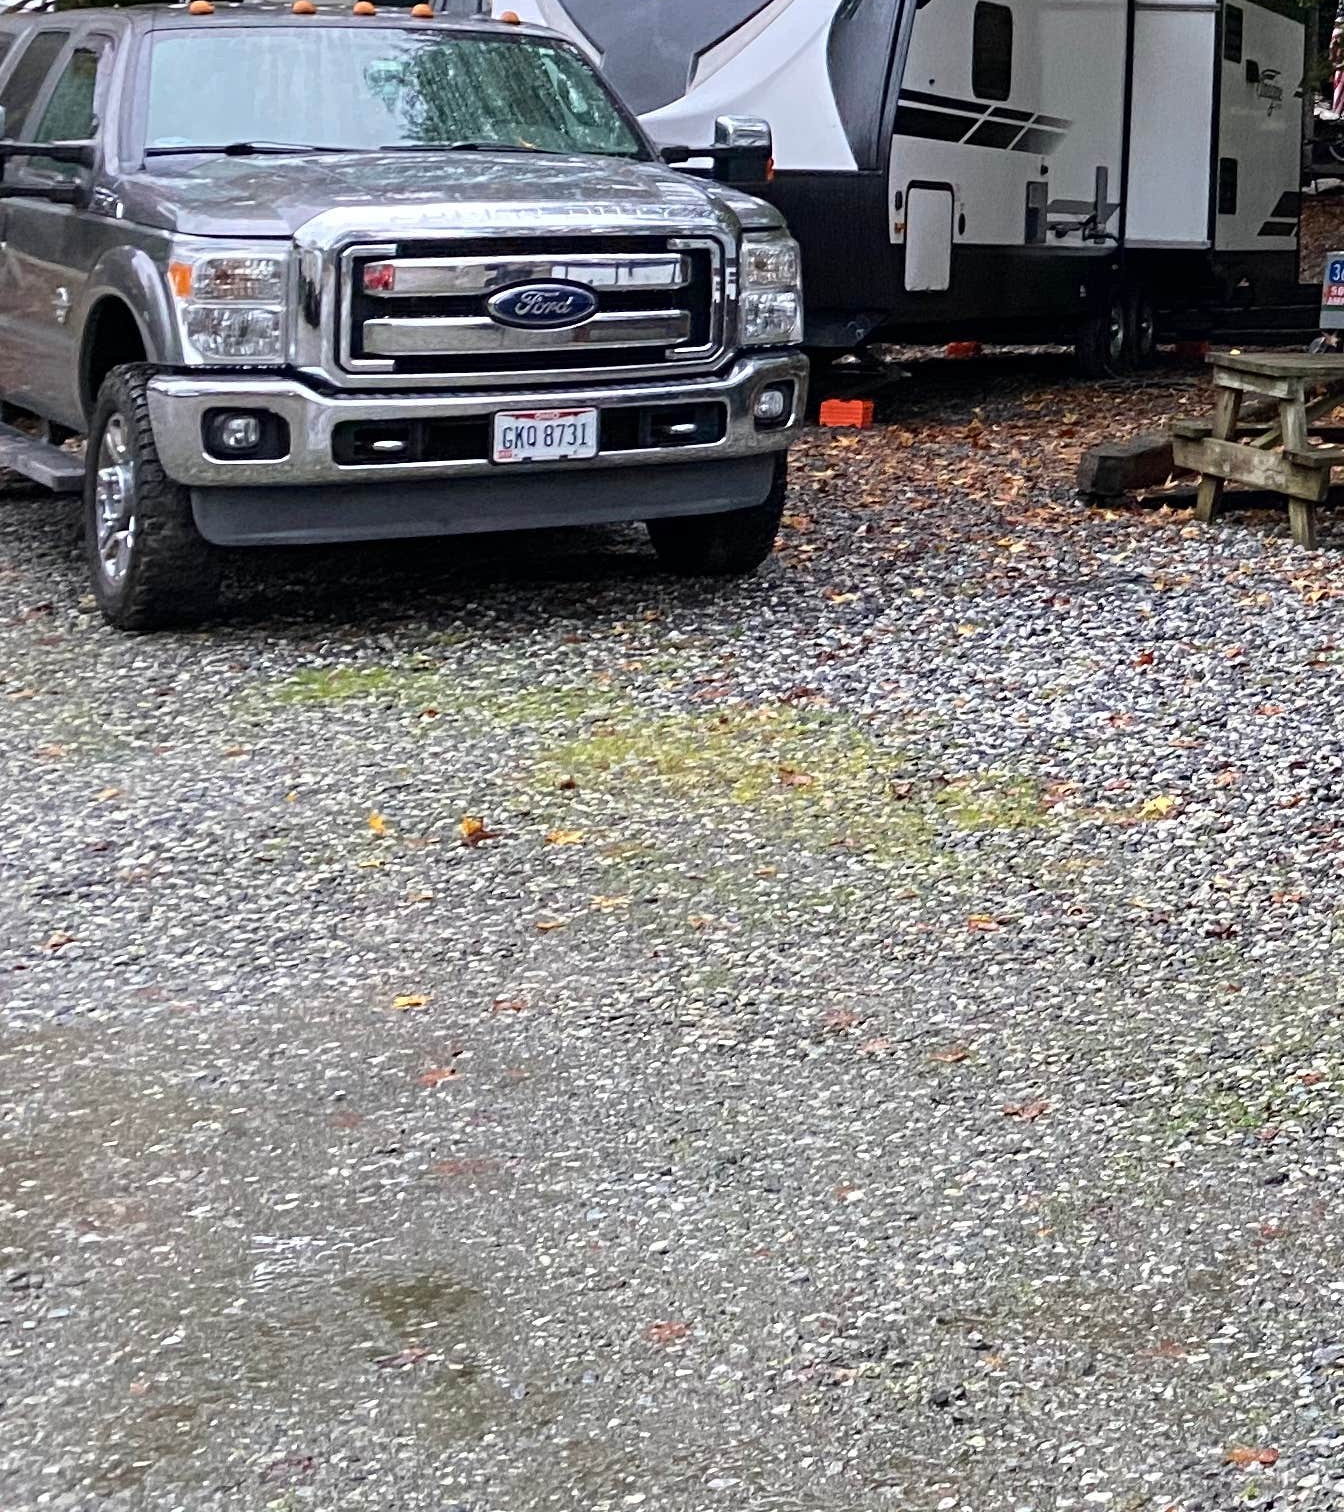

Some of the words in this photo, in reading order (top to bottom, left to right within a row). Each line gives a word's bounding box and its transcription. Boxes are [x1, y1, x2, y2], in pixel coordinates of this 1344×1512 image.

[514, 289, 574, 316] Ford
[502, 425, 538, 449] GKQ
[543, 422, 588, 448] 8731
